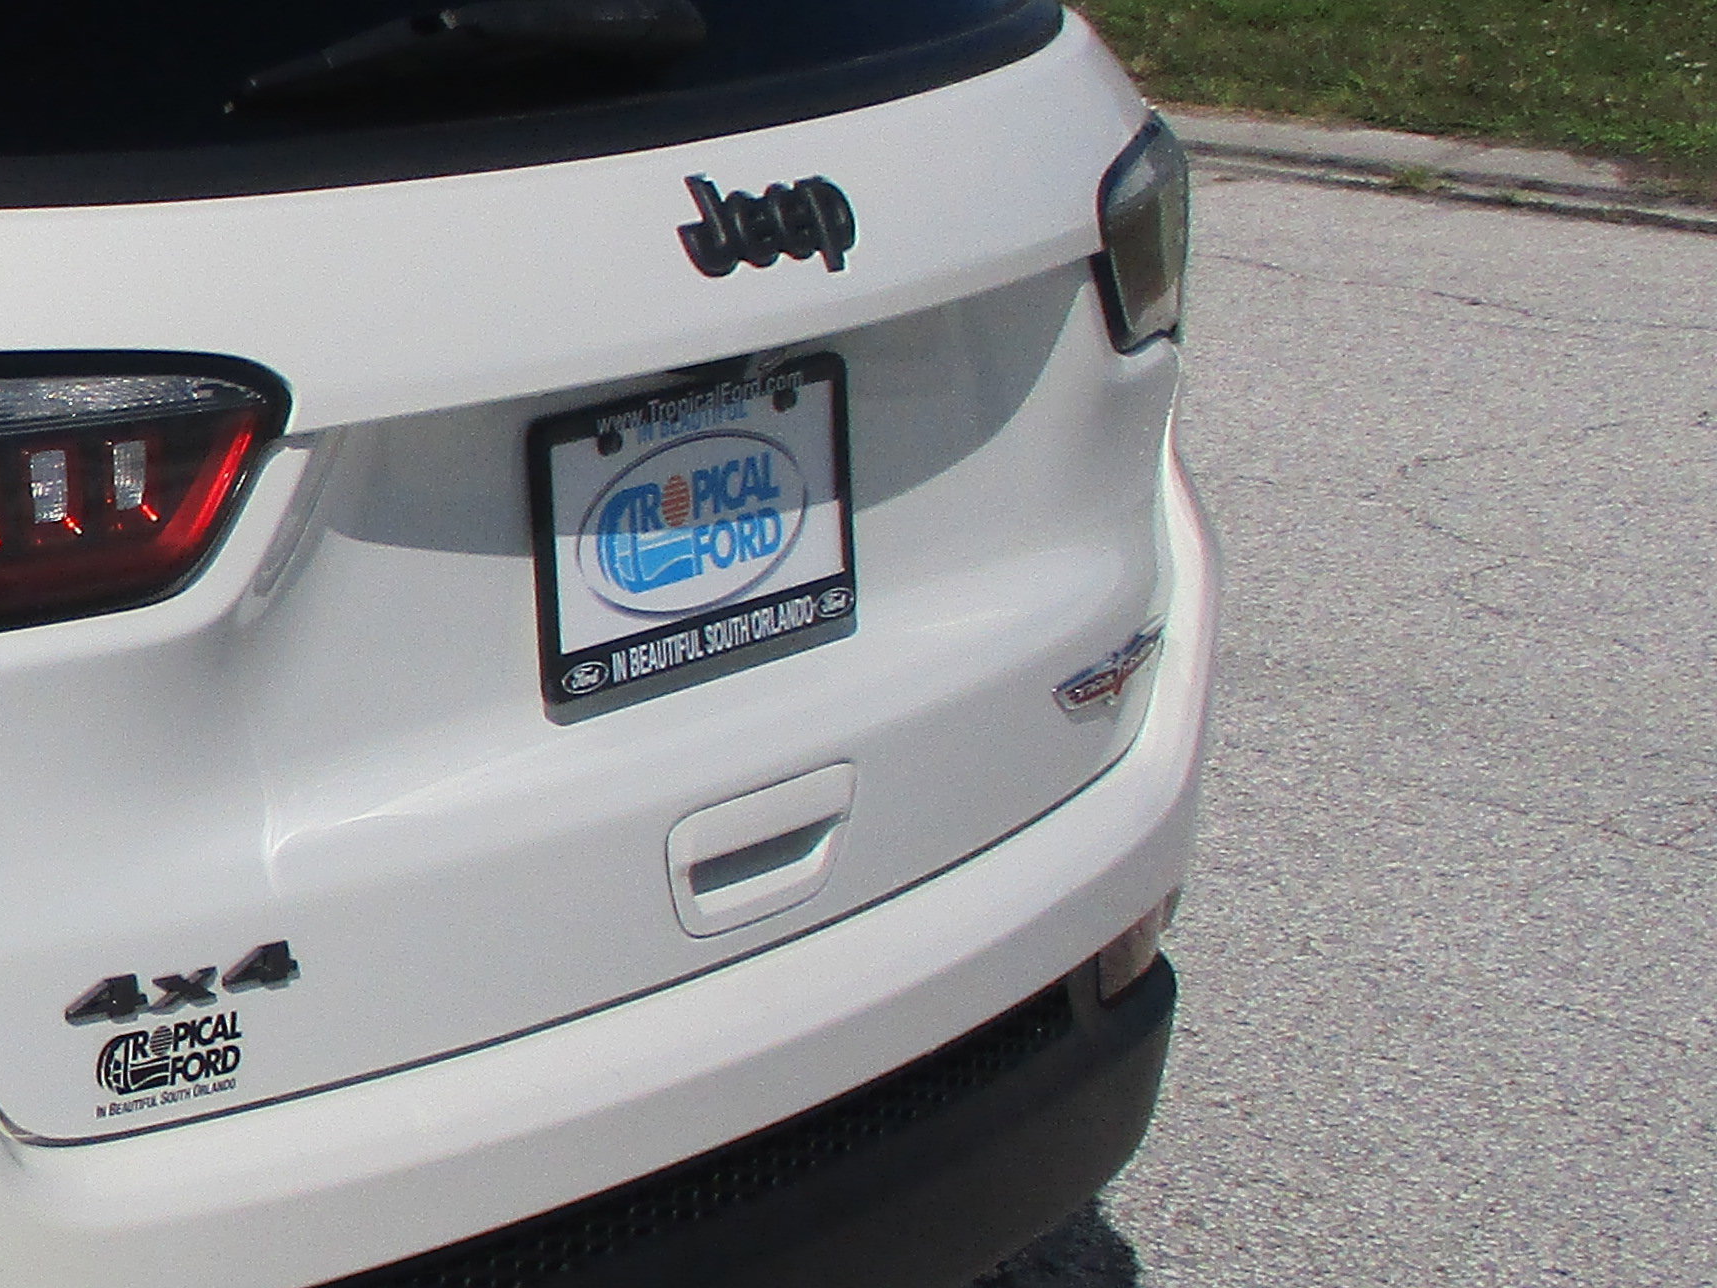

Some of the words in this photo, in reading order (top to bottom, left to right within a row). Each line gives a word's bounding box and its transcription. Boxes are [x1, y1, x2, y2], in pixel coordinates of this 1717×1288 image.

[676, 172, 857, 277] Jeep
[691, 507, 784, 576] FORD
[611, 650, 630, 683] IN
[628, 632, 704, 679] BEAUTIFUL
[704, 614, 752, 655] SOUTH
[751, 594, 814, 641] ORLANDO
[169, 1044, 243, 1087] FORD
